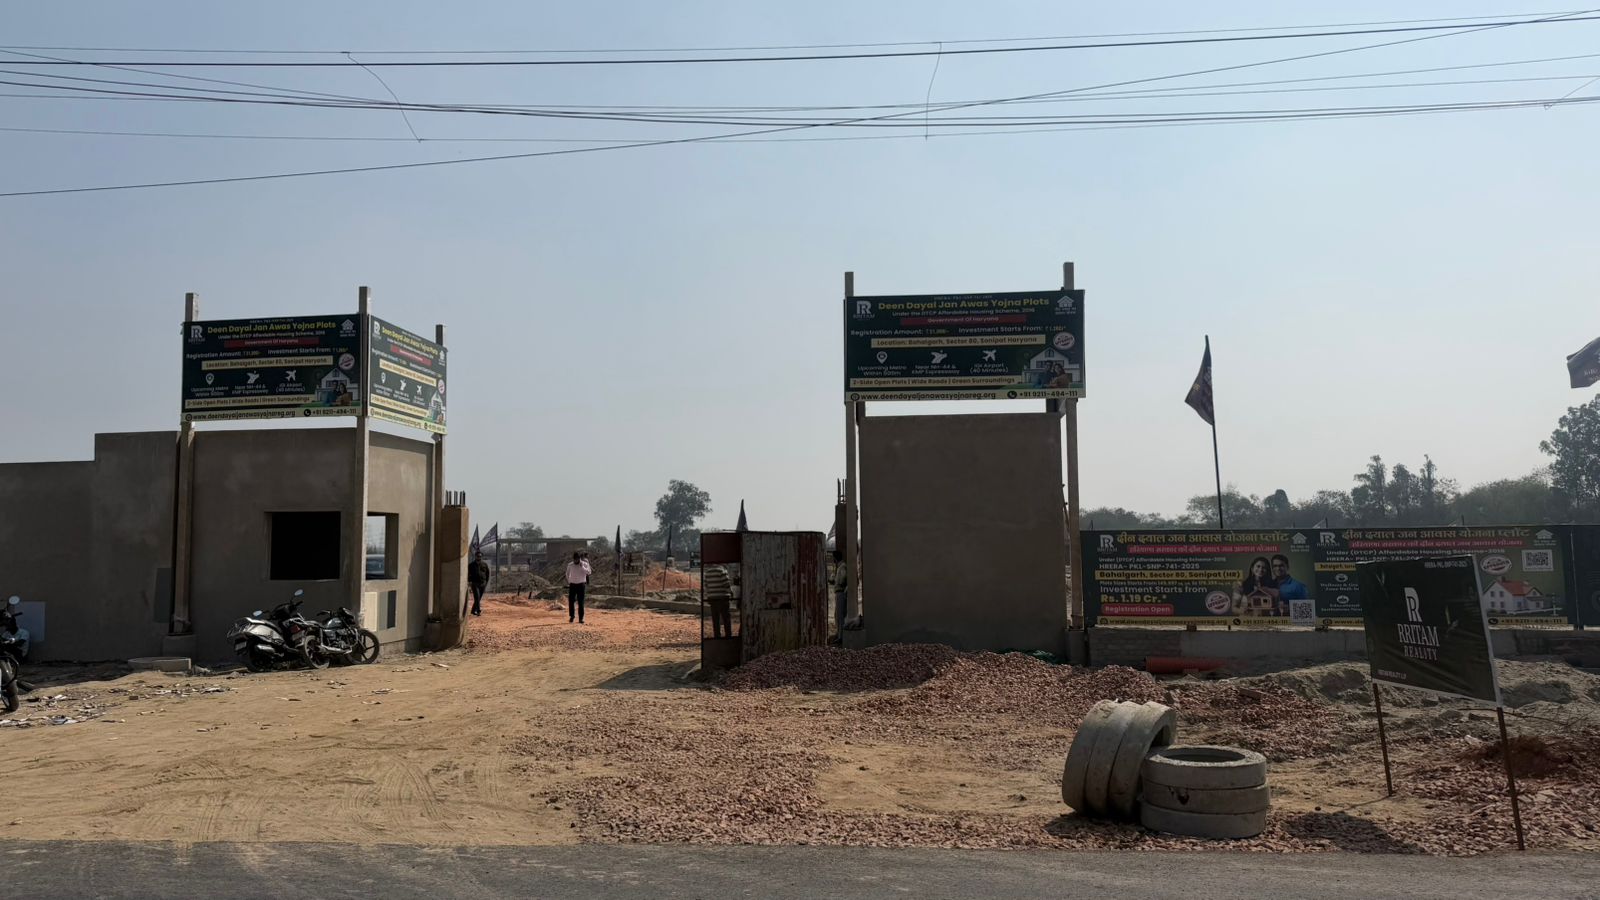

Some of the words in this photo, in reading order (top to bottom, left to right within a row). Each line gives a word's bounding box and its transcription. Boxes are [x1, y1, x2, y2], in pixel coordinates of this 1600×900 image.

[906, 301, 937, 312] Dayal
[939, 300, 958, 308] Jan
[991, 298, 1022, 308] Yojna
[229, 325, 252, 335] Dayal
[292, 322, 316, 331] Yojna
[1116, 532, 1136, 544] दीन
[1138, 534, 1165, 544] दयाल
[1168, 534, 1186, 543] जन
[1188, 534, 1222, 543] आवास
[1224, 530, 1258, 542] योजना
[1260, 530, 1290, 542] प्लॉट
[1342, 530, 1362, 540] दीन
[1364, 531, 1395, 540] दयाल
[1398, 531, 1416, 539] जन
[1420, 530, 1456, 538] आवास
[1458, 527, 1495, 538] योजना
[1498, 527, 1531, 537] प्लॉट
[1100, 571, 1147, 579] Bahalgarh,
[1101, 594, 1118, 603] Rs.
[1120, 594, 1141, 603] 1.19
[1398, 624, 1440, 647] RRITAM
